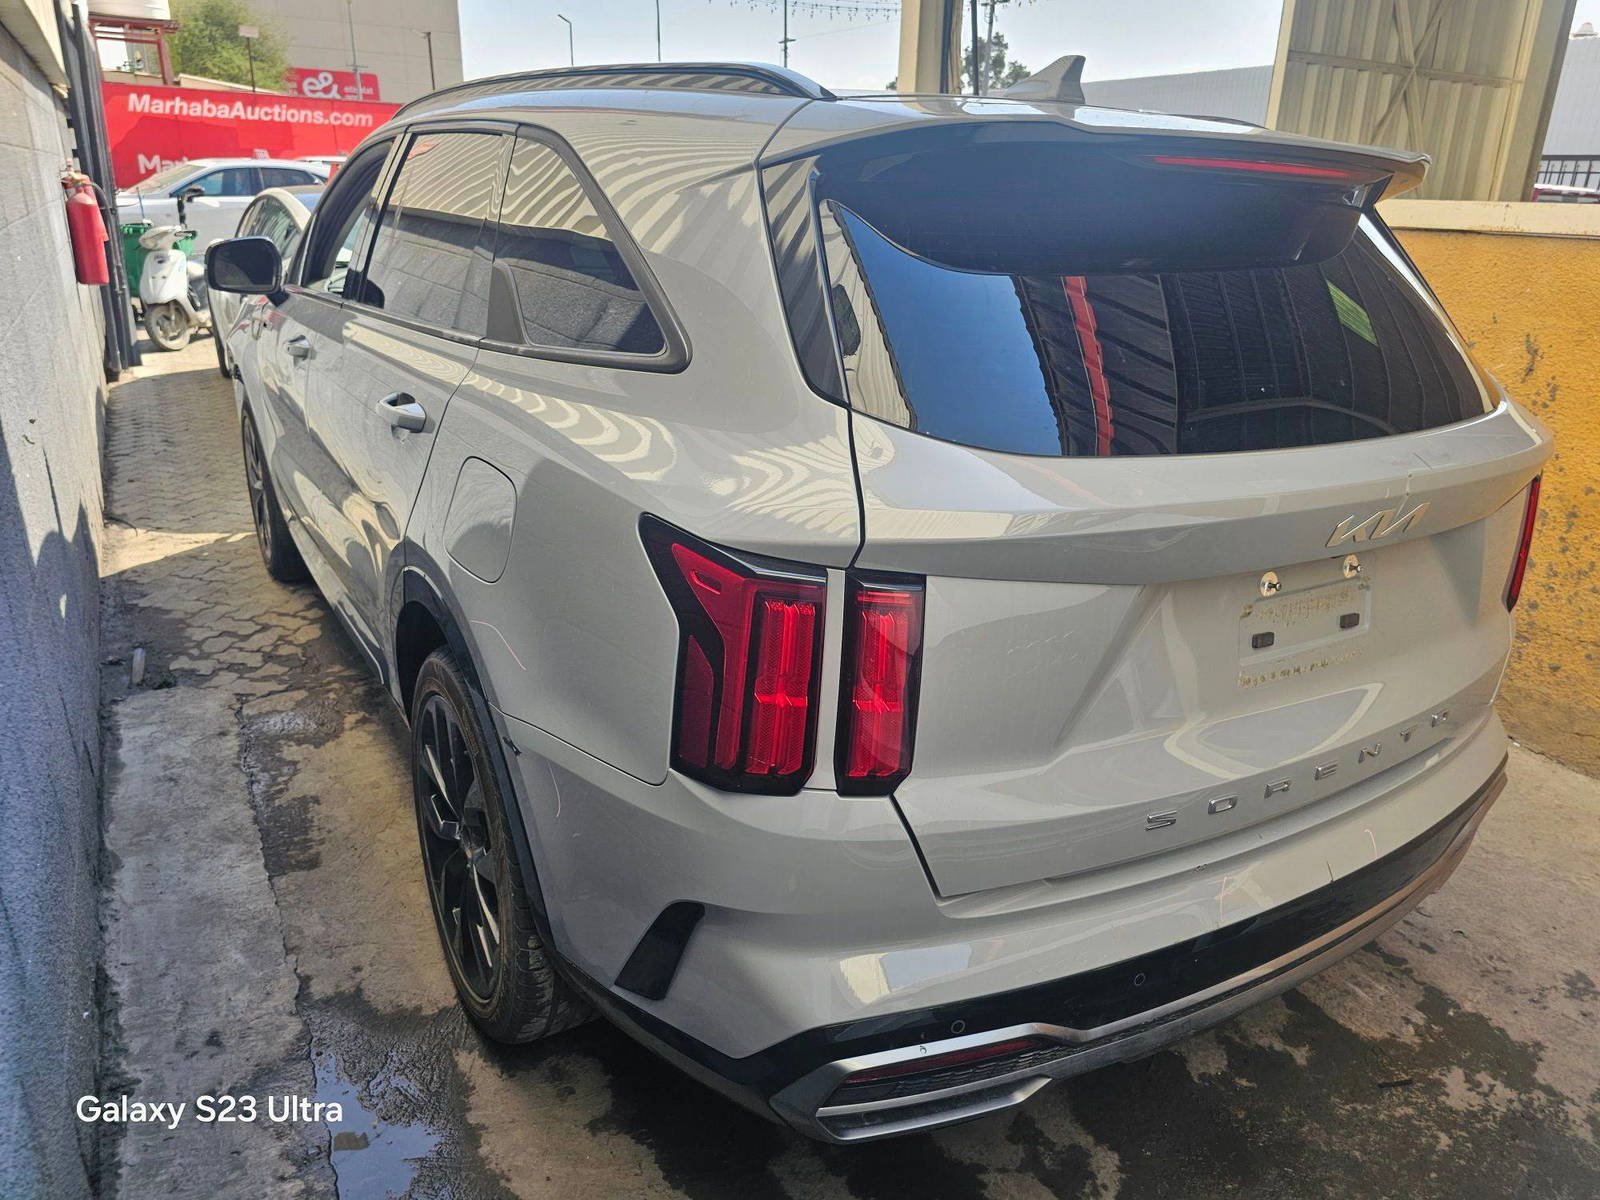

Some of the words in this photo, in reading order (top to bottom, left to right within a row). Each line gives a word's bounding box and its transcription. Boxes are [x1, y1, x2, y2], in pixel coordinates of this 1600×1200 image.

[128, 93, 373, 127] MarhabaAuctions.com
[1325, 502, 1430, 547] KIA
[1145, 710, 1448, 831] SORENTO
